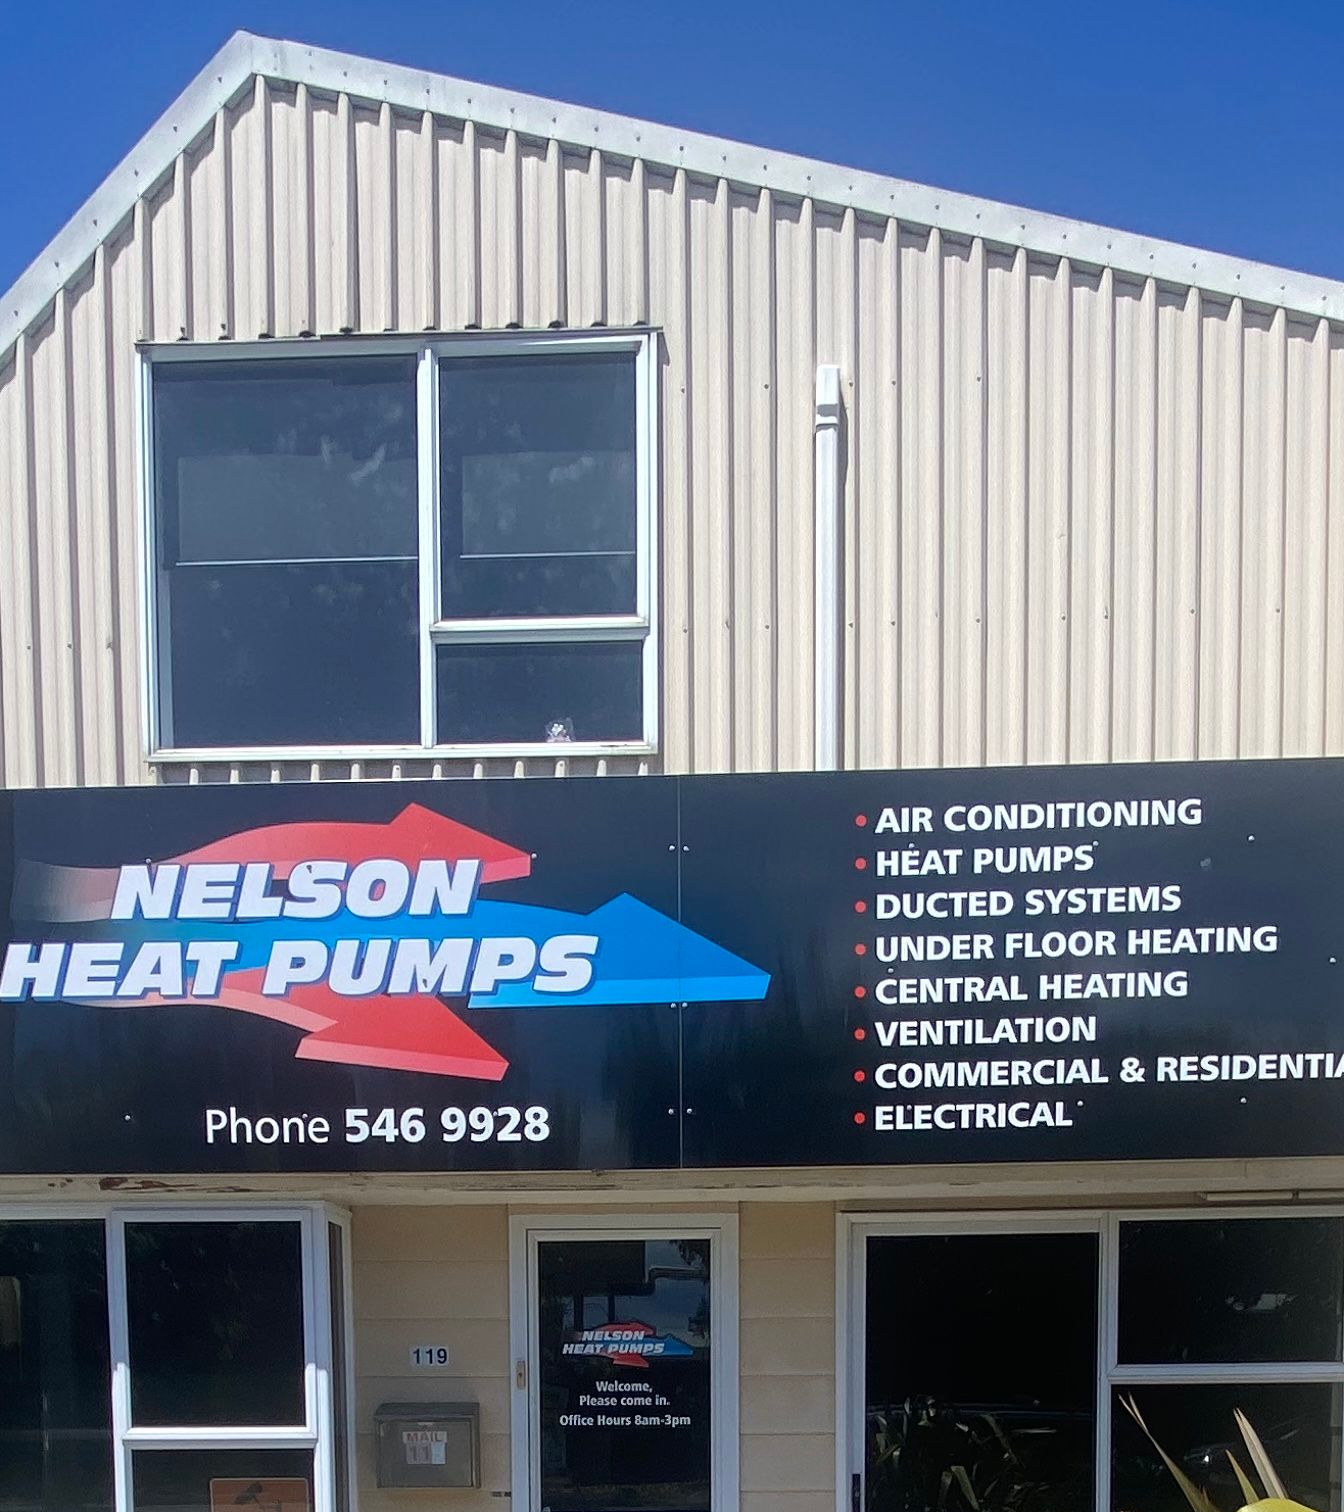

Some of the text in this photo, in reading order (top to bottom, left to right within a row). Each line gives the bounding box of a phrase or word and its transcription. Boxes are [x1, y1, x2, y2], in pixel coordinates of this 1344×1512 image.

[874, 799, 1203, 834] AIR CONDITIONING
[876, 845, 1095, 877] HEAT PUMPS
[111, 857, 482, 920] NELSON
[876, 886, 1182, 919] DUCTED SYSTEMS
[876, 926, 1278, 963] UNDER FLOOR HEATING
[261, 935, 600, 996] PUMPS
[875, 971, 1188, 1005] CENTRAL HEATING
[875, 1016, 1096, 1048] VENTILATION
[875, 1058, 1108, 1089] COMMERCIAL
[1120, 1057, 1146, 1083] &
[206, 1107, 551, 1143] Phone 546 9928
[875, 1102, 1073, 1131] ELECTRICAL
[562, 1343, 665, 1354] HEAT PUMPS
[582, 1330, 645, 1342] NELSON
[412, 1347, 448, 1365] 119
[579, 1394, 670, 1406] Please come in.
[596, 1380, 653, 1393] Welcome,
[559, 1414, 691, 1428] Office Hours 8am-3pm
